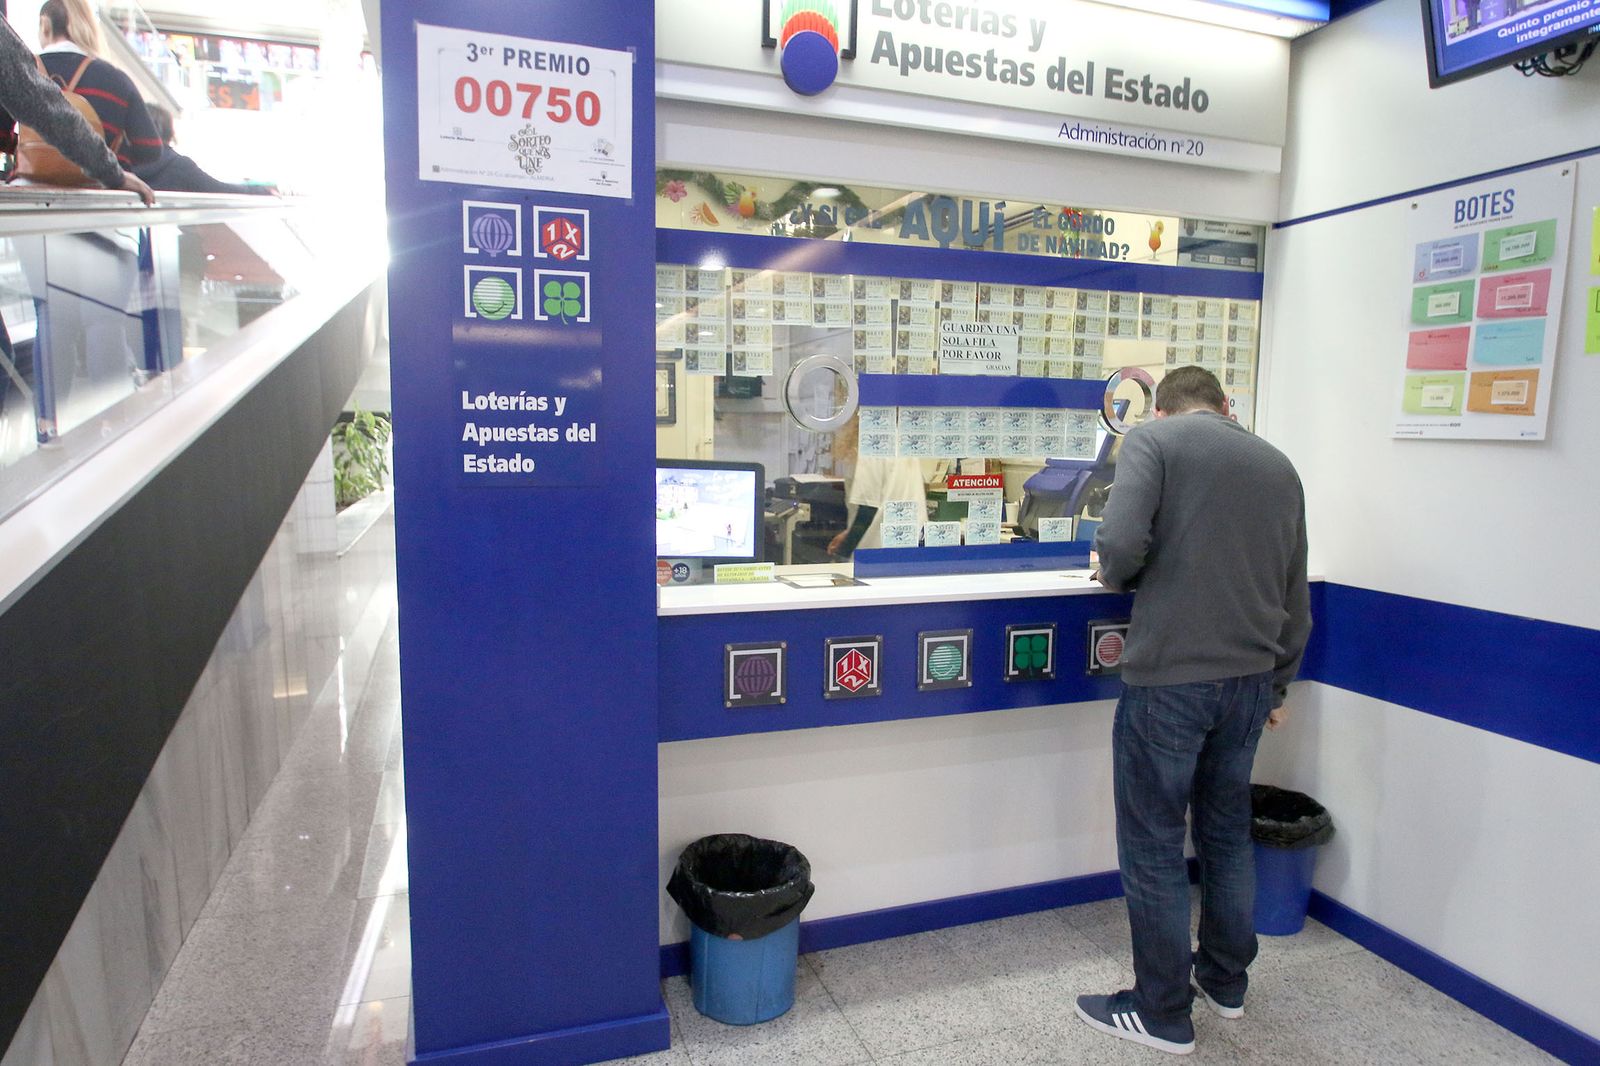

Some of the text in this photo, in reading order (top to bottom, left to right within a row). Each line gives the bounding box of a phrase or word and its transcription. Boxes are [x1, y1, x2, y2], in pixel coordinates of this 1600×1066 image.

[1497, 0, 1590, 38] Quinto premio
[1028, 18, 1047, 52] y
[503, 48, 590, 76] PREMIO
[870, 30, 1209, 113] Apuestas del Estado
[454, 76, 601, 127] 00750
[508, 135, 552, 151] SORTEO
[1058, 122, 1166, 151] Administración
[1186, 139, 1204, 156] 20
[515, 155, 543, 175] UNE
[1454, 188, 1515, 223] BOTES
[1032, 208, 1052, 229] EL
[1058, 213, 1115, 235] GORDO
[1017, 233, 1130, 260] DE NAVIDAD?
[942, 322, 1017, 335] GUARDEN UNA
[942, 336, 996, 347] SOLA FILA
[942, 349, 1001, 360] POR FAVOR
[462, 390, 567, 416] Loterías y
[462, 422, 597, 446] Apuestas del
[463, 453, 535, 473] Estado
[953, 476, 999, 487] ATENCIÓN
[674, 566, 688, 575] +18
